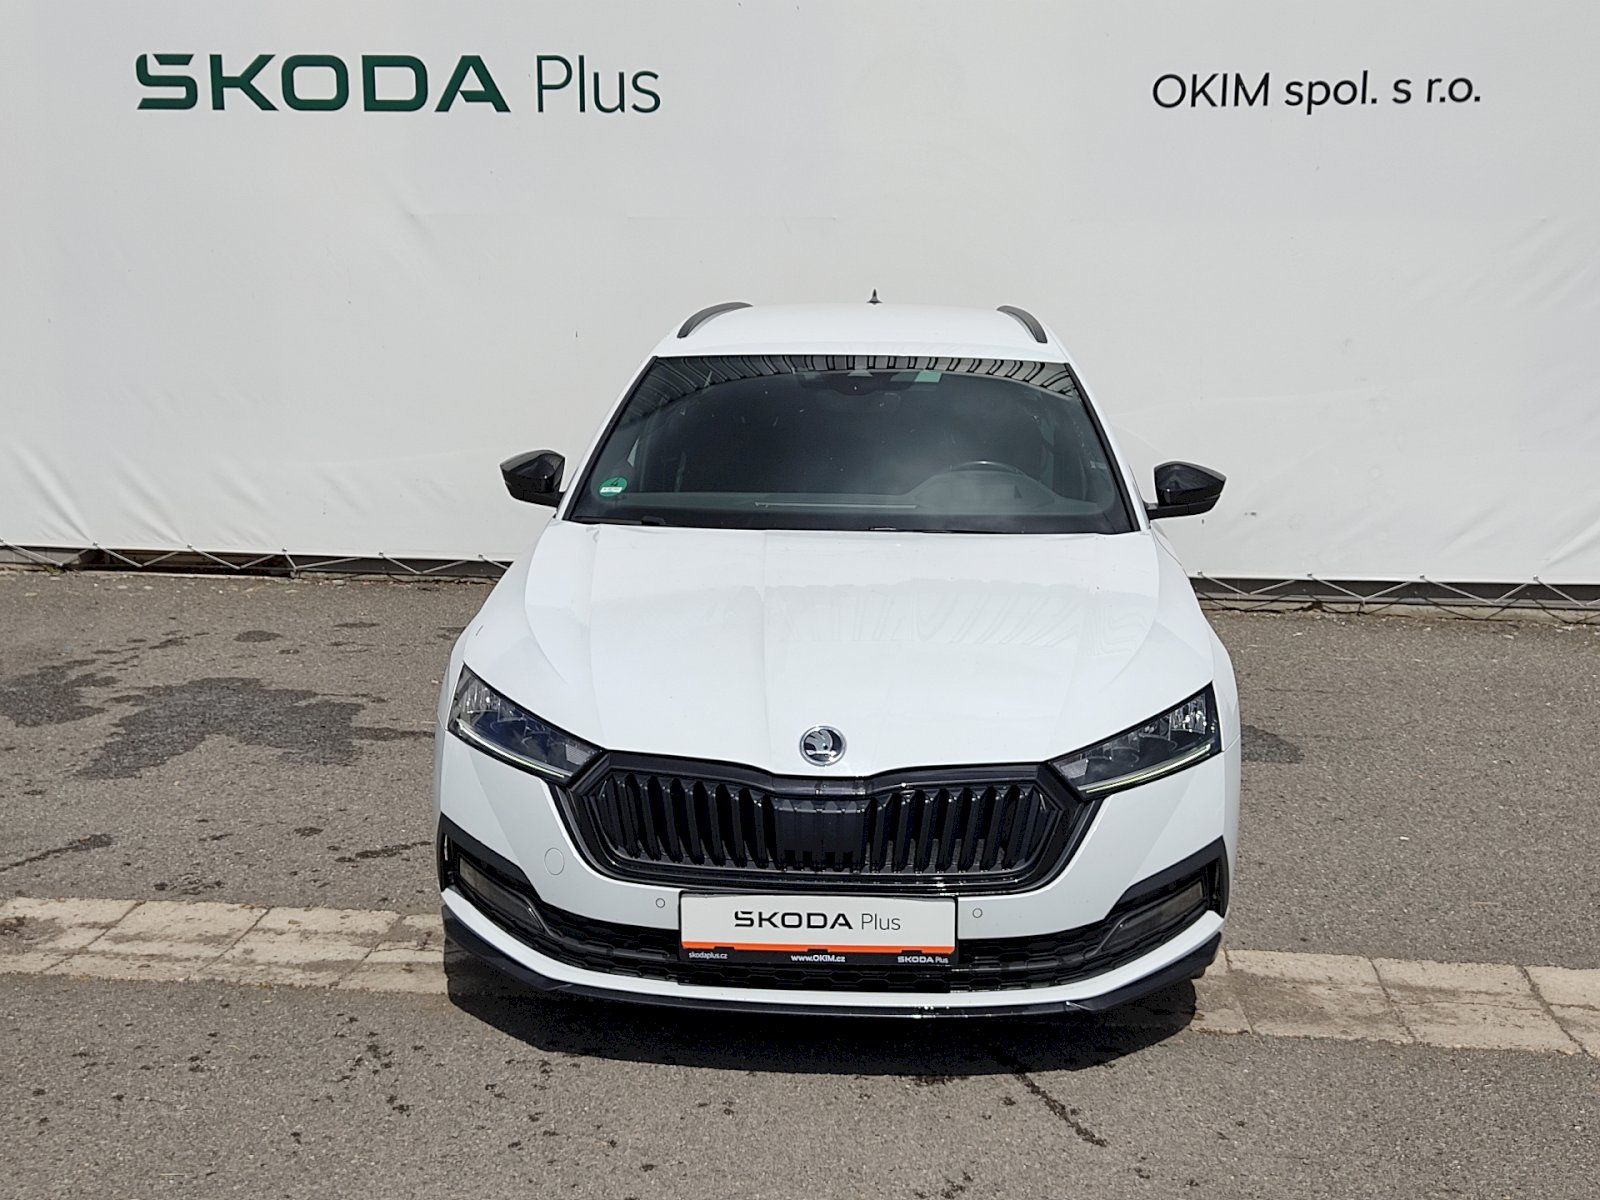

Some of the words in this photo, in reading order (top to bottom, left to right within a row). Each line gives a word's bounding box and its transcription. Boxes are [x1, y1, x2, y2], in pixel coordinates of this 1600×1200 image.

[536, 54, 661, 114] Plus
[1152, 72, 1270, 108] OKIM
[1284, 69, 1378, 115] spol.
[1391, 76, 1412, 104] s
[1426, 76, 1481, 104] r.o.
[861, 913, 901, 931] Plus
[688, 951, 728, 960] skodaplus.cz
[790, 954, 846, 964] www.OKIM.cz
[935, 955, 949, 964] Plus
